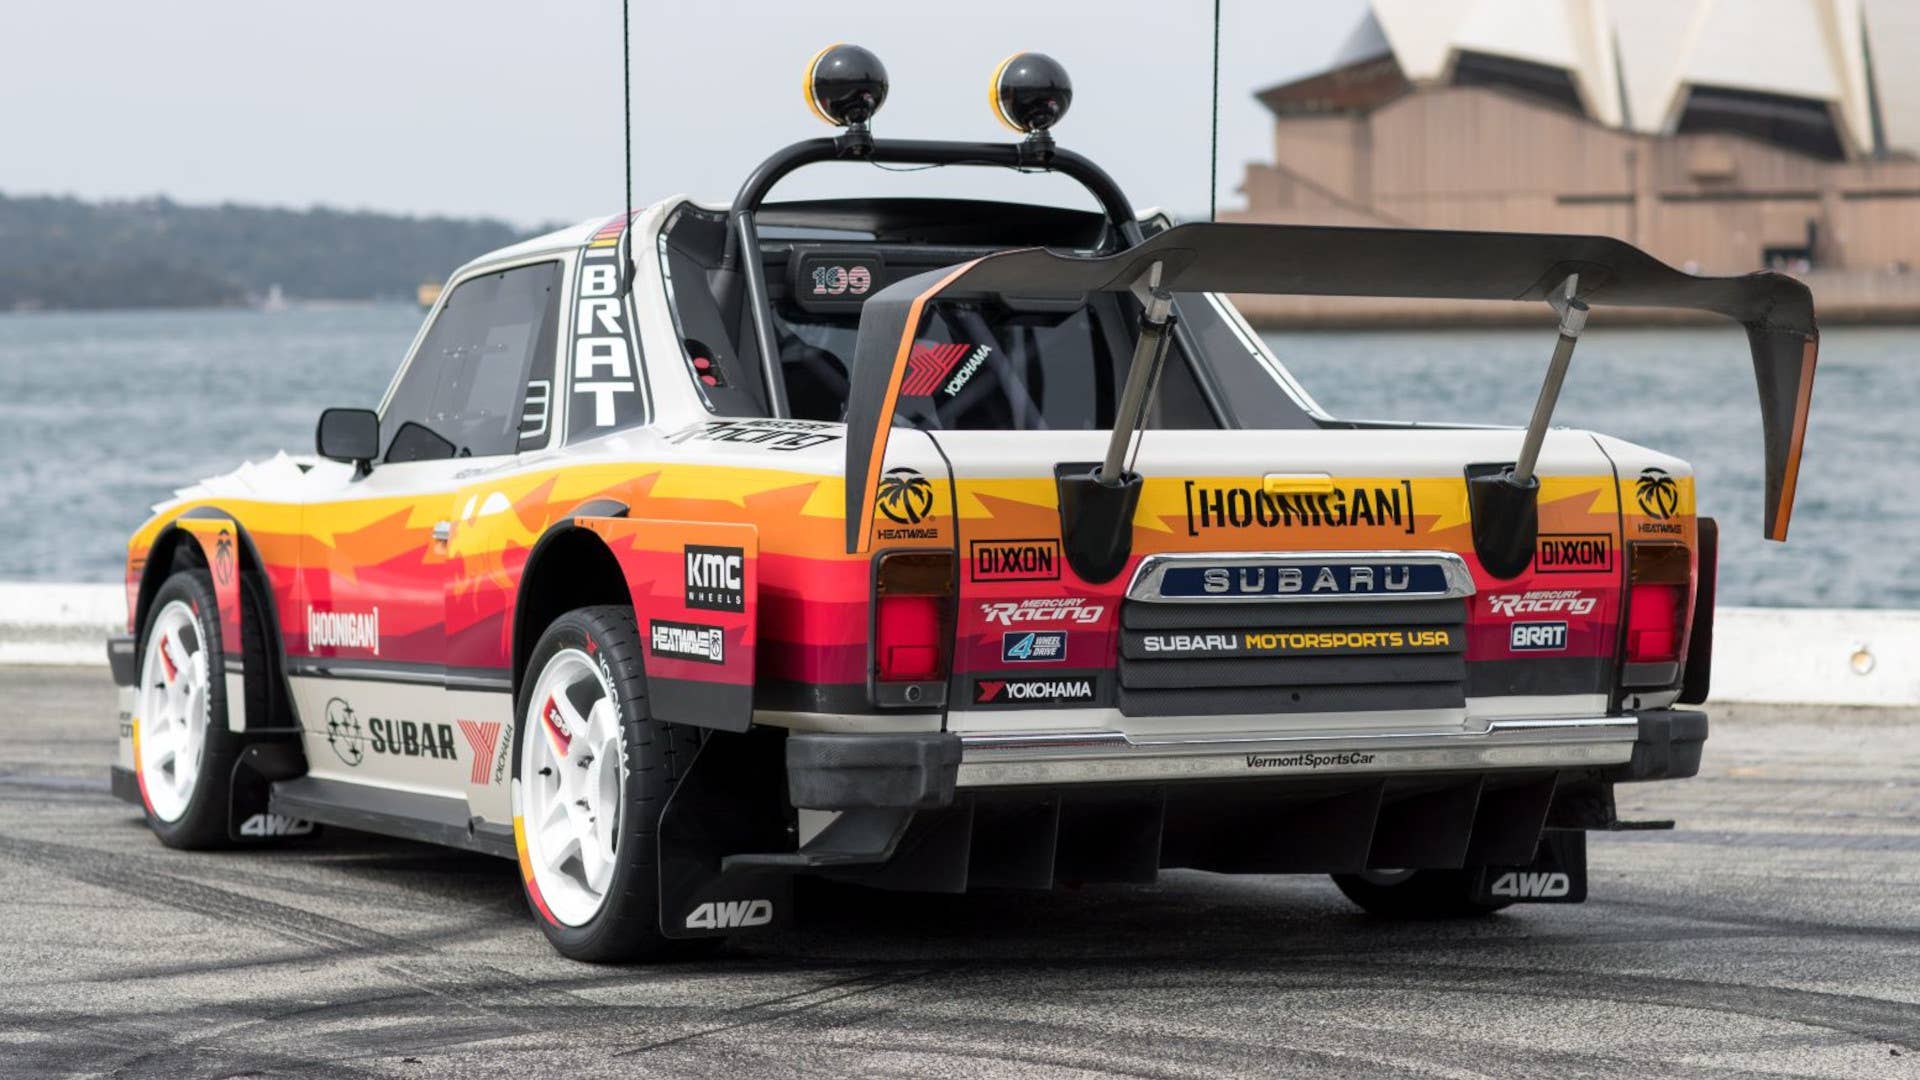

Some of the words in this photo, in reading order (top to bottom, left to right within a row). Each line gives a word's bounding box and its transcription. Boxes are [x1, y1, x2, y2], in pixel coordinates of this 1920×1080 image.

[812, 265, 872, 295] 199
[574, 264, 635, 427] BRAT
[944, 344, 993, 397] YOKOHAMA
[877, 528, 938, 539] HEATWAVE
[978, 546, 1053, 574] DIXXON
[1541, 540, 1606, 566] DIXXON
[687, 552, 742, 590] KMC
[1203, 566, 1411, 593] SUBARU
[688, 591, 742, 605] WHEELS
[1021, 598, 1087, 608] MERCURY
[1490, 595, 1597, 617] Racing
[1522, 590, 1582, 600] MERCURY
[982, 603, 1105, 626] Racing
[651, 625, 710, 656] HEATWAVE
[1008, 632, 1035, 659] 4
[1034, 636, 1061, 647] WHEEL
[1143, 635, 1238, 652] SUBARU
[1245, 632, 1404, 650] MOTORSPORTS
[1408, 631, 1449, 647] USA
[1512, 624, 1566, 648] BRAT
[1032, 647, 1057, 656] DRIVE
[1005, 682, 1092, 699] YOKOHAMA
[1246, 753, 1375, 769] VermontSportsCar
[240, 813, 314, 837] 4WD
[1491, 872, 1570, 898] 4WD
[686, 900, 773, 930] 4WD
